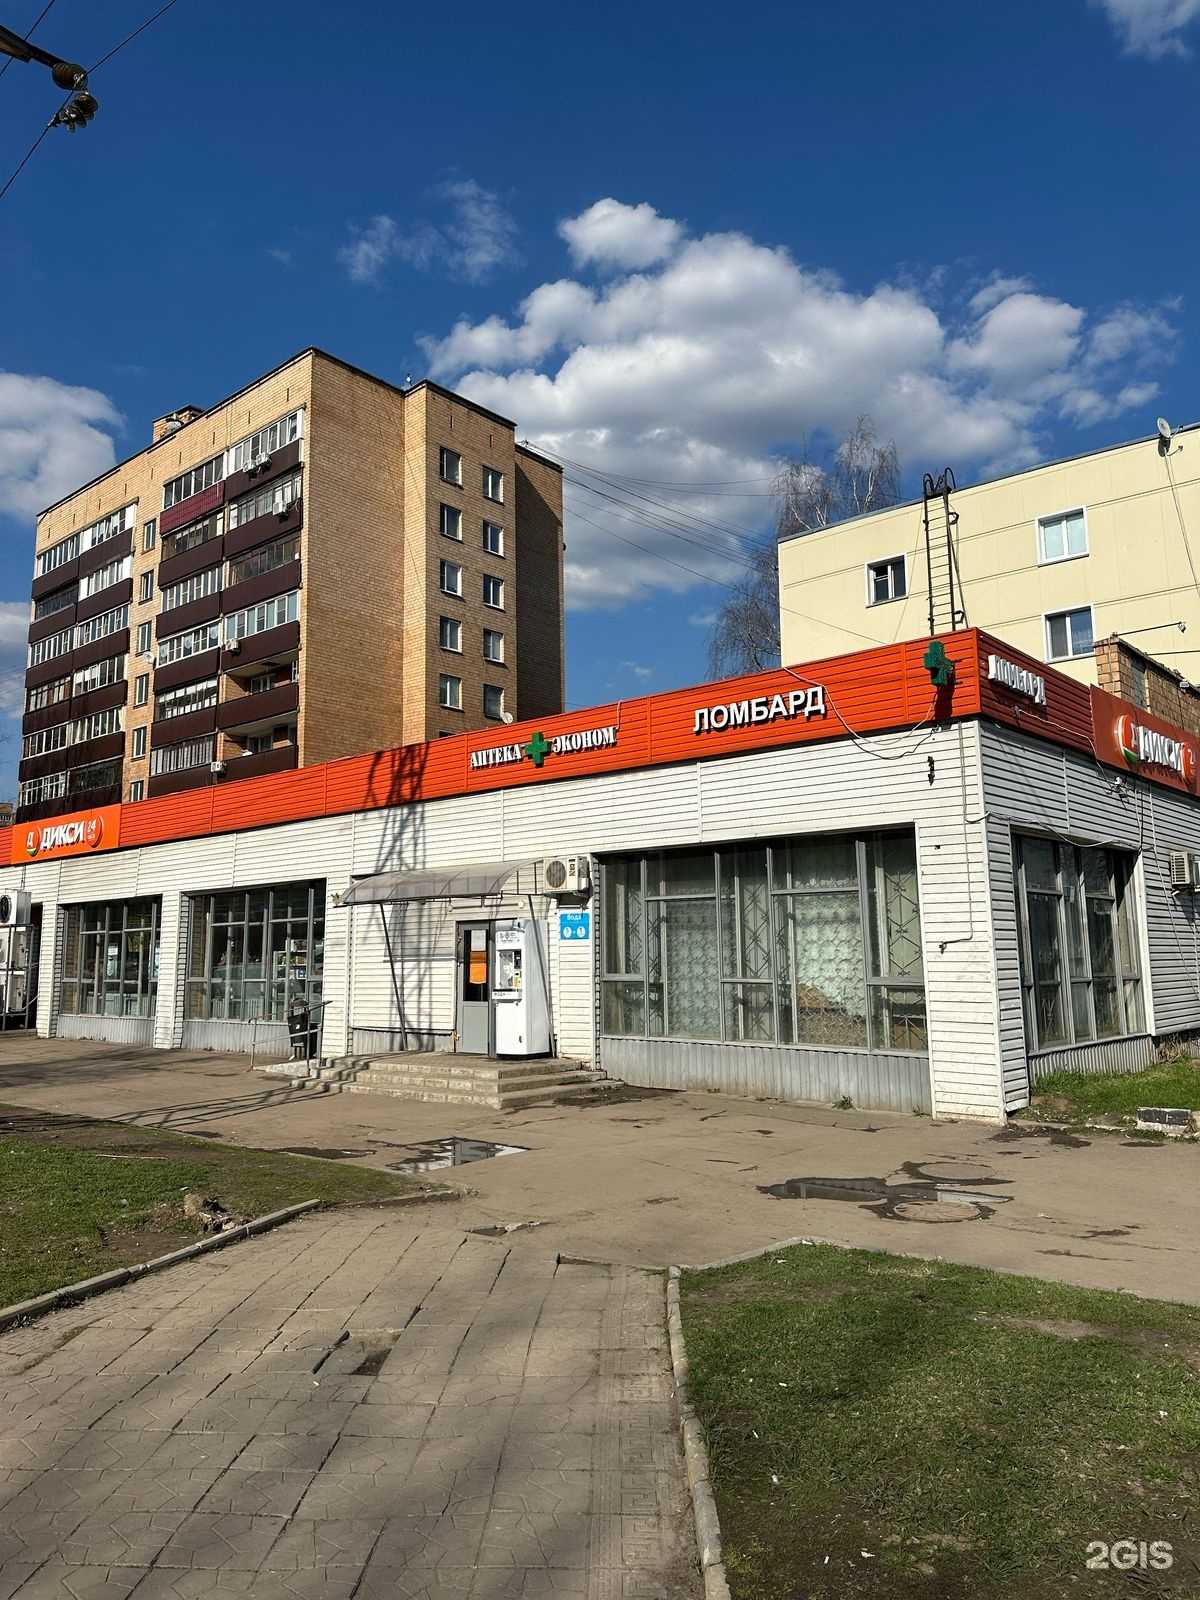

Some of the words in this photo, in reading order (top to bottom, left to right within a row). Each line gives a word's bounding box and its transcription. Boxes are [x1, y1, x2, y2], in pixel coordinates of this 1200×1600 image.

[693, 685, 826, 732] ЛОМБАРД
[470, 743, 522, 767] АПТЕКА
[552, 726, 617, 753] ЭКОНОМ
[40, 821, 85, 851] ДИКСИ
